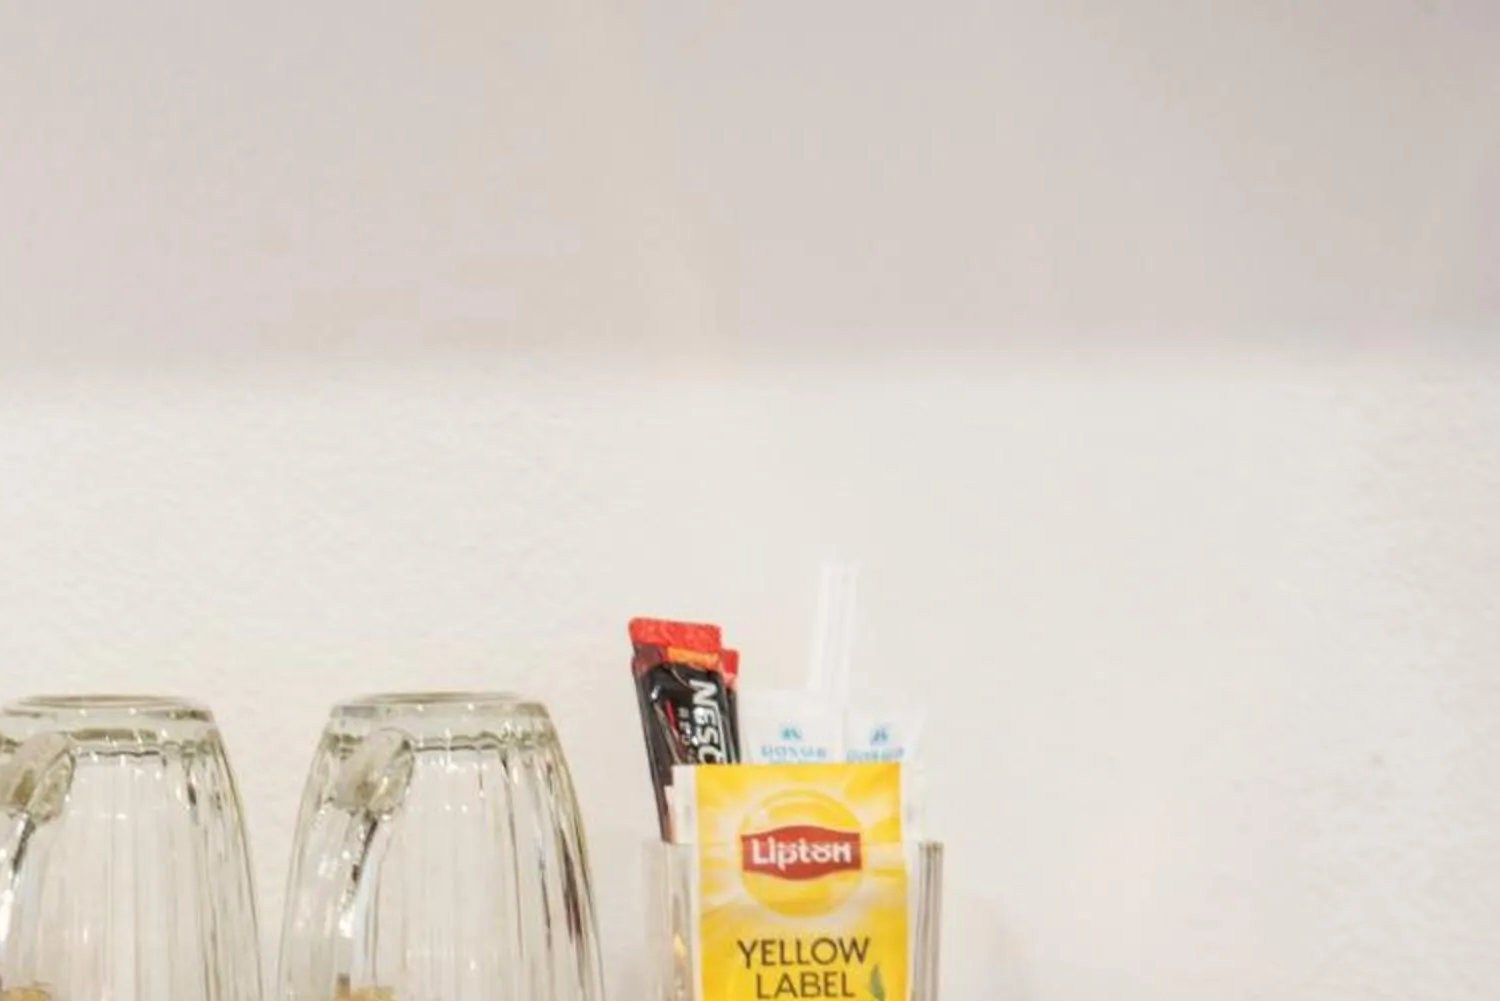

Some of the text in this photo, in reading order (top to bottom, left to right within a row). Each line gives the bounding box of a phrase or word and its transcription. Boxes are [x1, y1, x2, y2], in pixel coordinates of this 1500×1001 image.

[751, 836, 852, 871] Lipton
[737, 936, 871, 970] YELLOW
[756, 970, 856, 1000] LABEL
